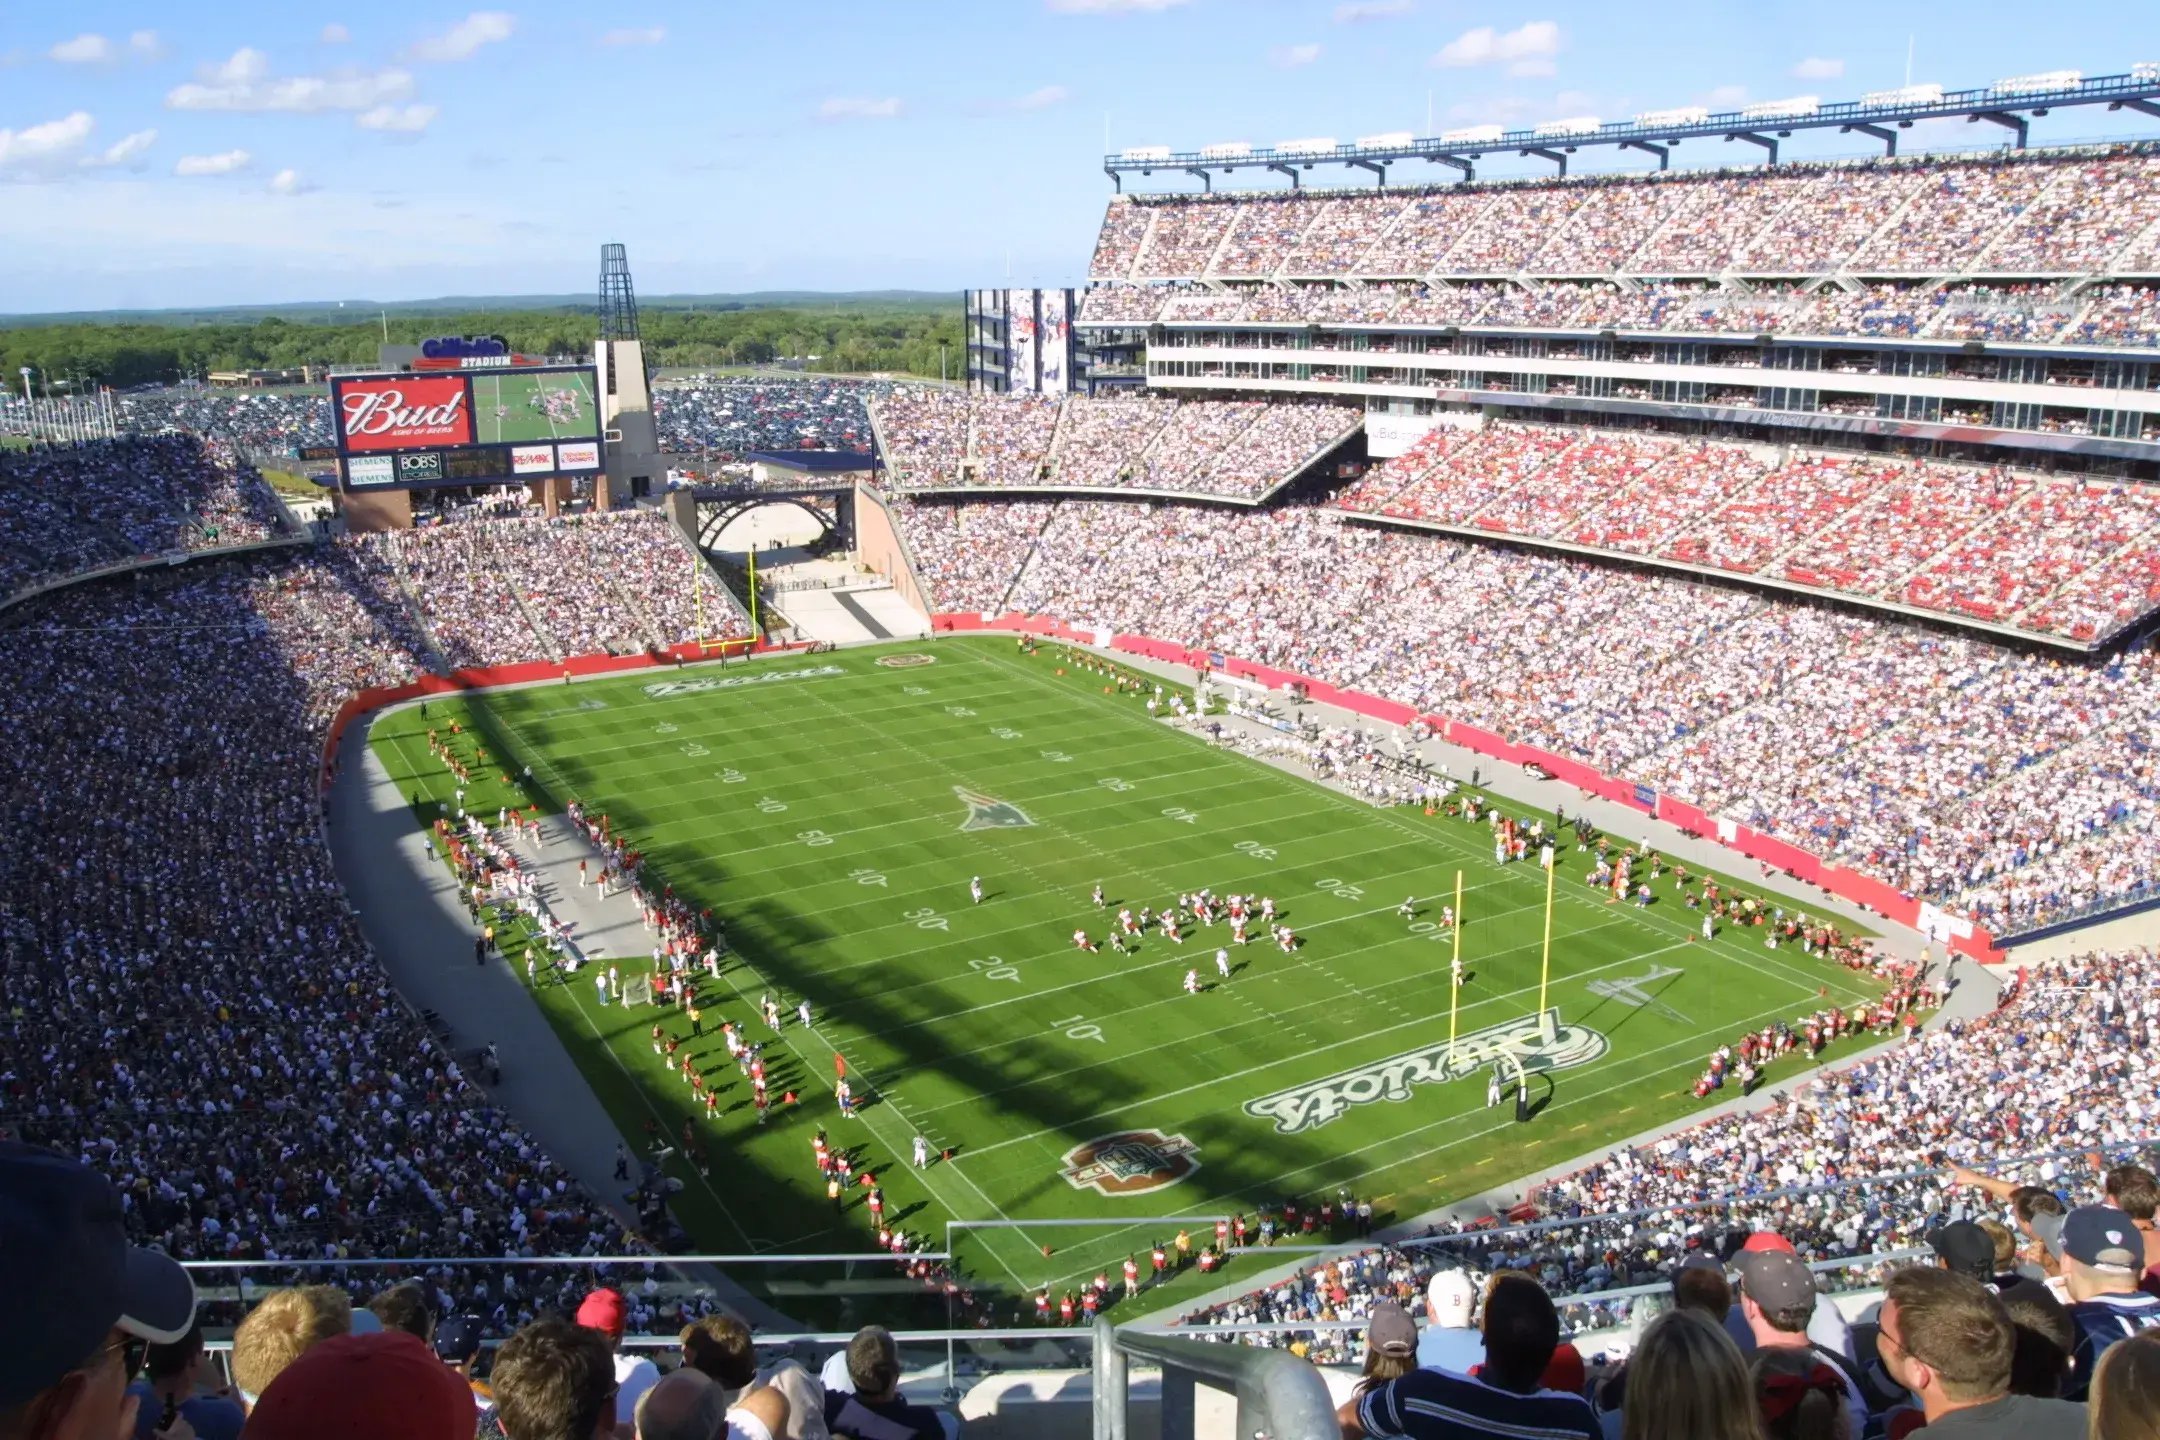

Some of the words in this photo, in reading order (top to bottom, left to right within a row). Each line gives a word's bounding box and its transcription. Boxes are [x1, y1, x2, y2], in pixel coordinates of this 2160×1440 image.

[461, 355, 511, 368] STADIUM
[342, 390, 464, 435] Bud
[349, 457, 393, 467] SIEMENS
[351, 474, 394, 483] SIEMENS
[1161, 806, 1200, 824] 40
[796, 829, 835, 848] 50
[1233, 840, 1278, 861] 30
[848, 868, 887, 886] 40
[1314, 878, 1365, 901] 20
[903, 907, 945, 931] 30
[1407, 921, 1456, 945] 10
[968, 955, 1020, 982] 20
[1050, 1014, 1104, 1042] 10
[1452, 1294, 1461, 1307] B
